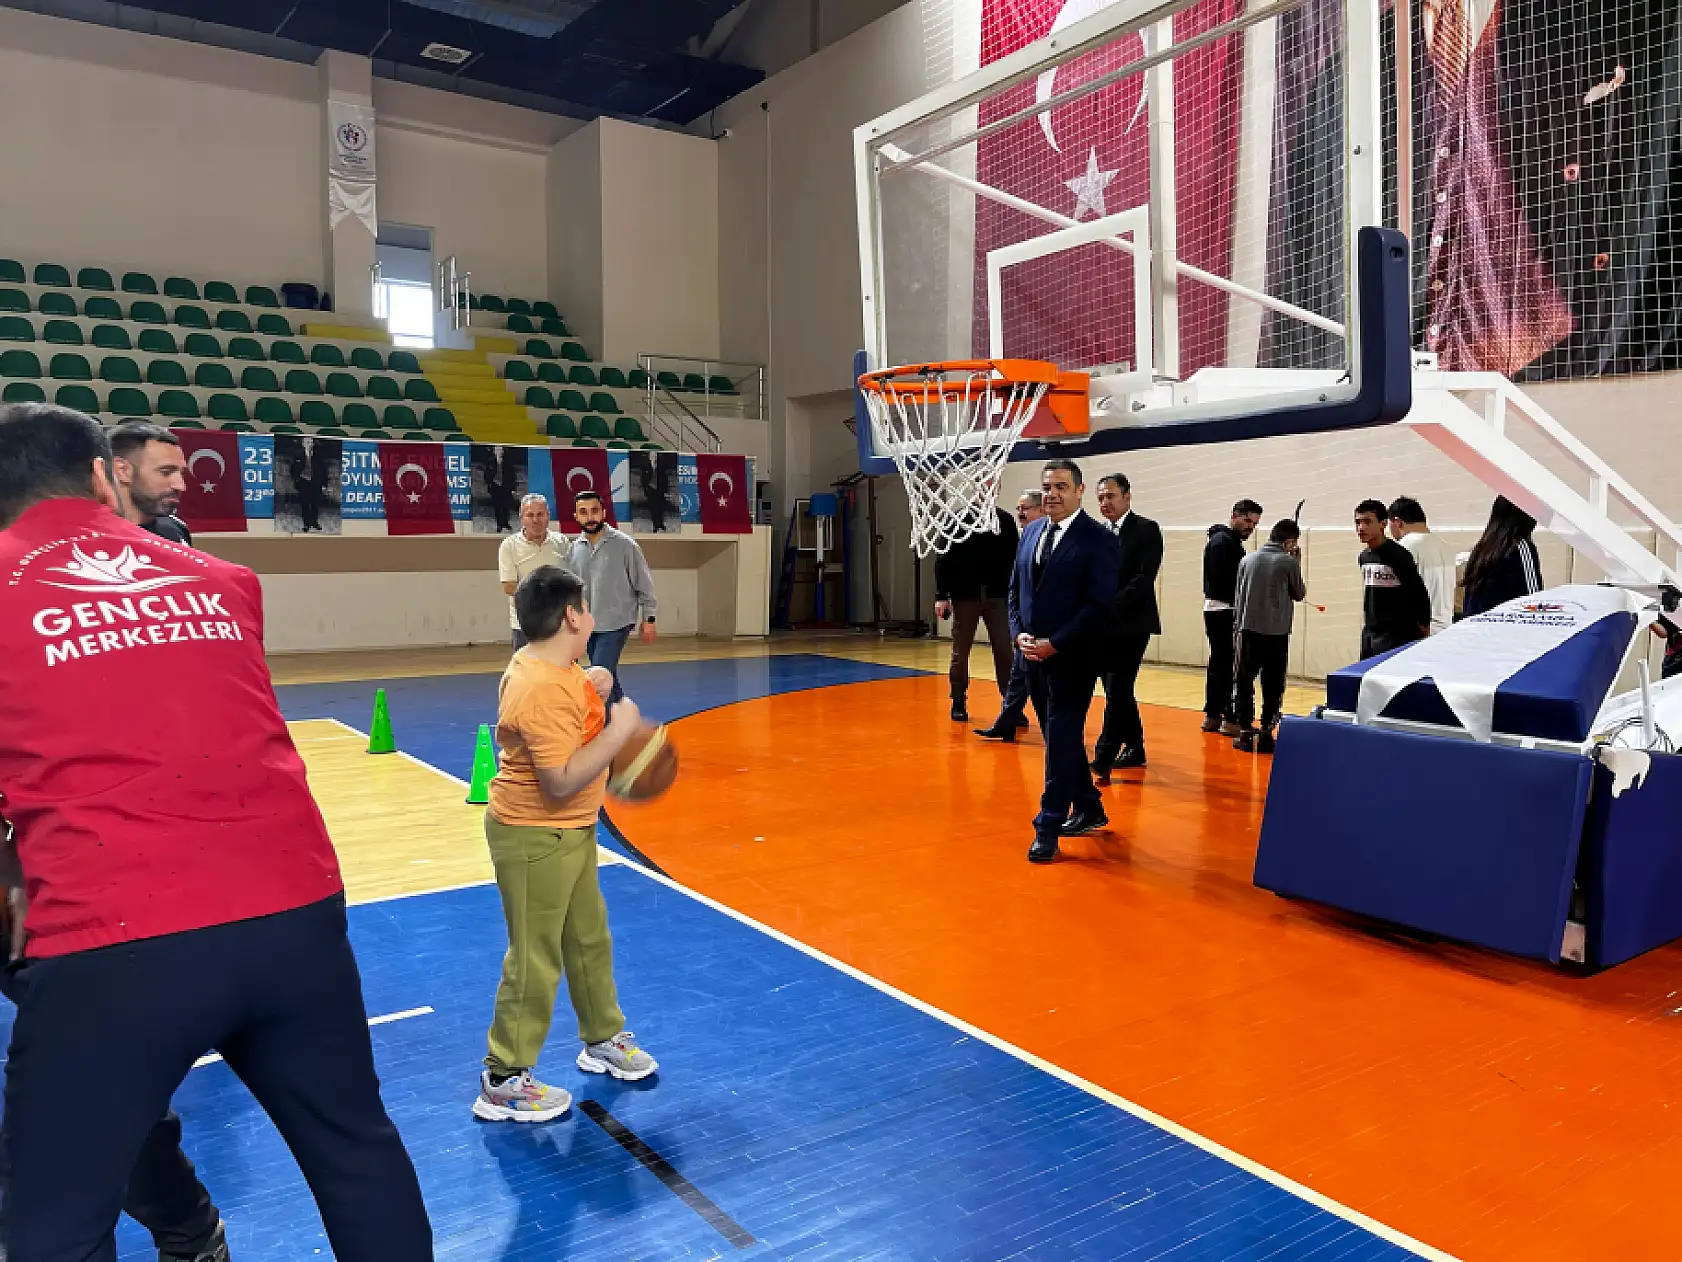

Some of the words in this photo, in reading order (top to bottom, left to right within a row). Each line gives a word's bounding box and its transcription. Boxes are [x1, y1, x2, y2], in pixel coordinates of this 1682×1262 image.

[245, 447, 273, 465] 23
[33, 591, 231, 637] GENÇLİK
[45, 620, 244, 667] MERKEZLERİ
